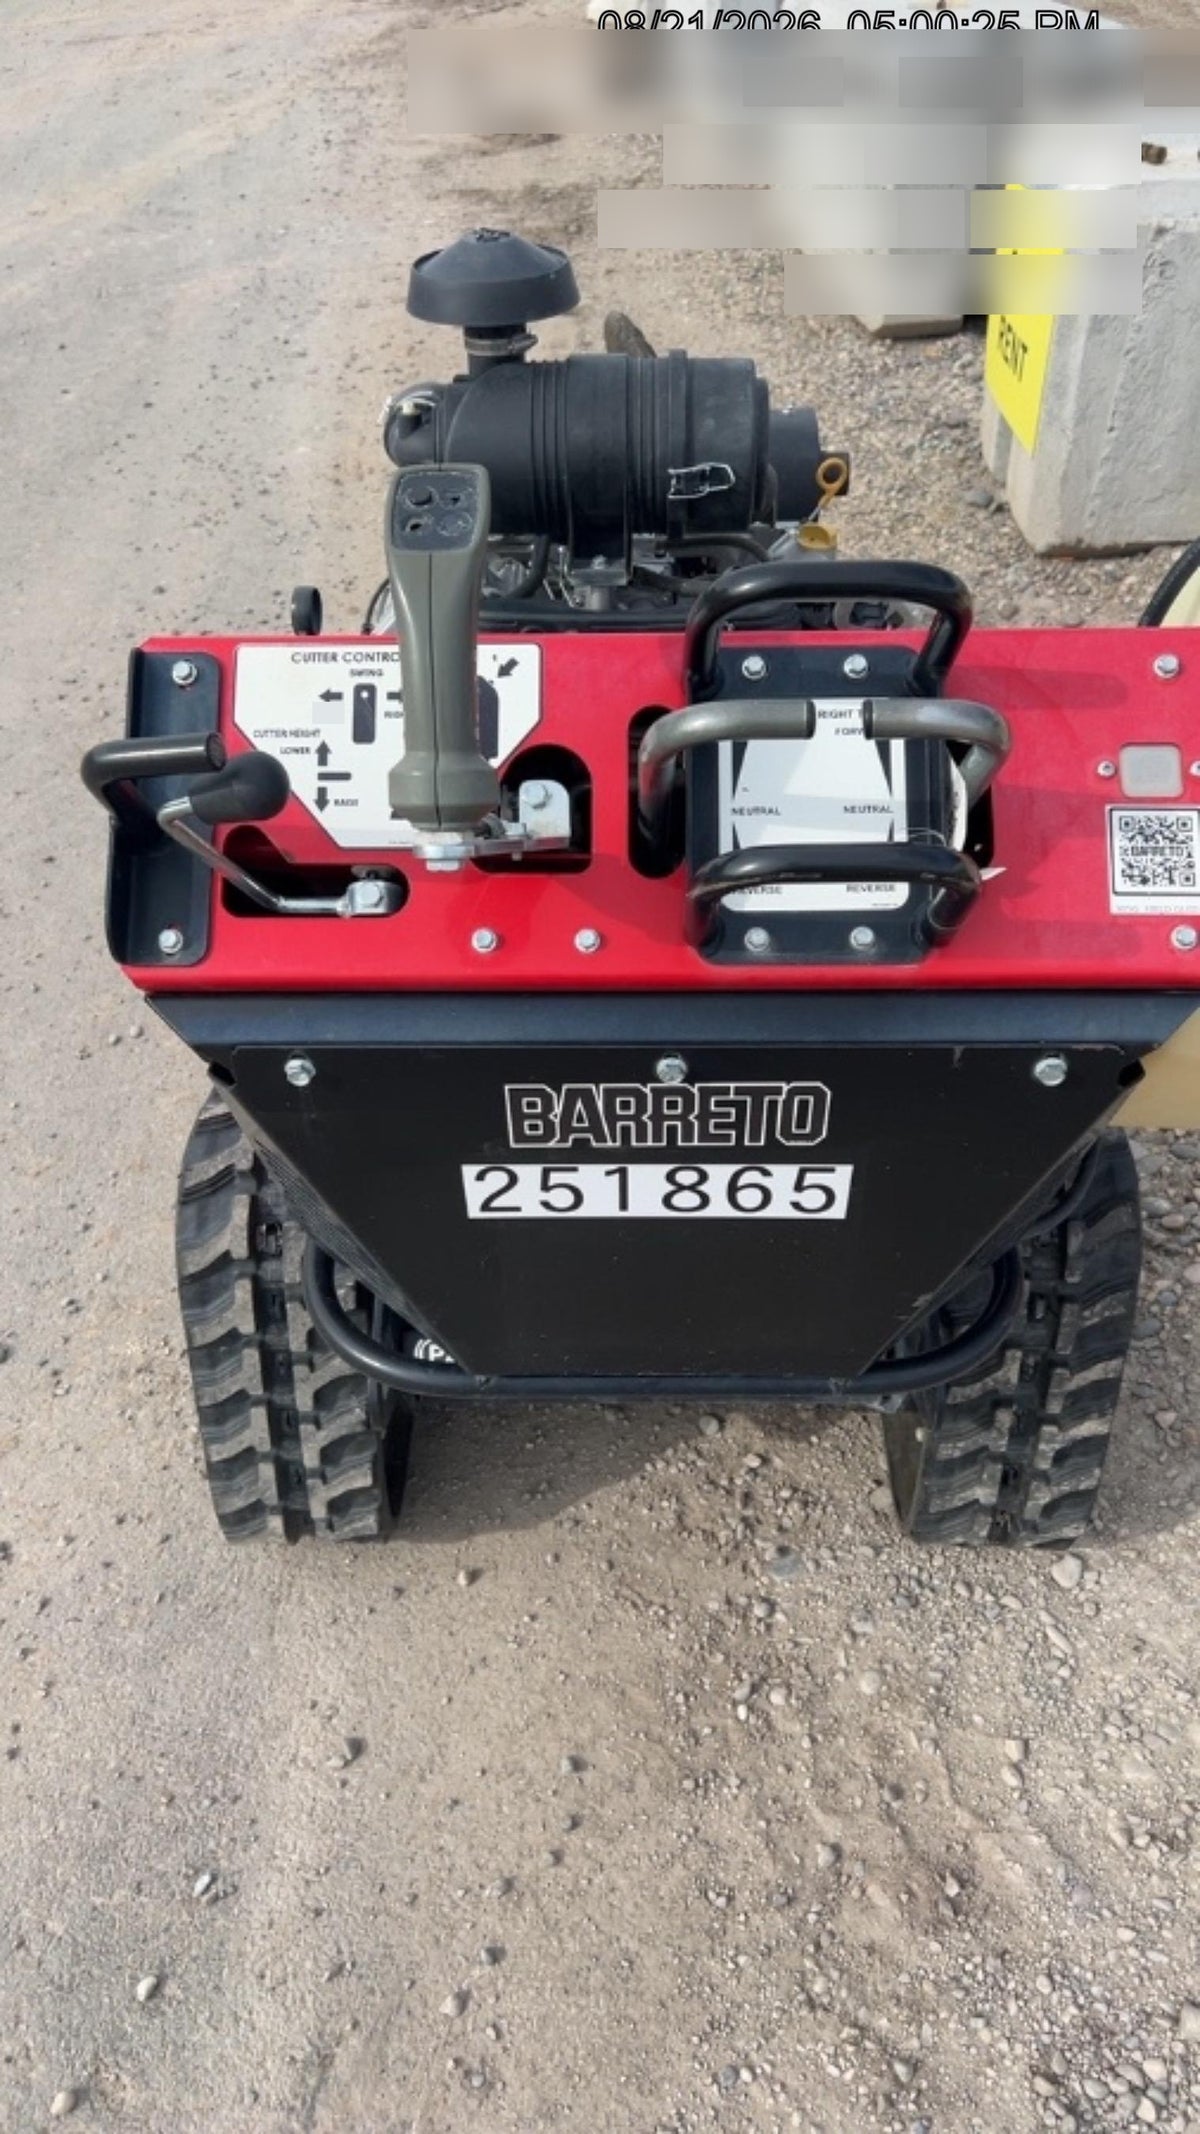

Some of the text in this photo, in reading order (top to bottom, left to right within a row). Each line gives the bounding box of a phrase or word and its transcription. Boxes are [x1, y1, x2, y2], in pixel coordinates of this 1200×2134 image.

[291, 652, 400, 664] CUTTER CONTRO
[350, 668, 384, 677] SWING
[384, 710, 405, 719] RIGH
[818, 709, 853, 719] RIGHT
[253, 728, 321, 738] CUTTER HEIGHT
[834, 727, 864, 735] FORW
[280, 746, 311, 755] LOWER
[731, 805, 781, 816] NEUTRAL
[843, 805, 894, 815] NEUTRAL
[846, 883, 895, 893] REVERSE
[504, 1082, 831, 1148] BARRETO
[473, 1165, 838, 1213] 251865
